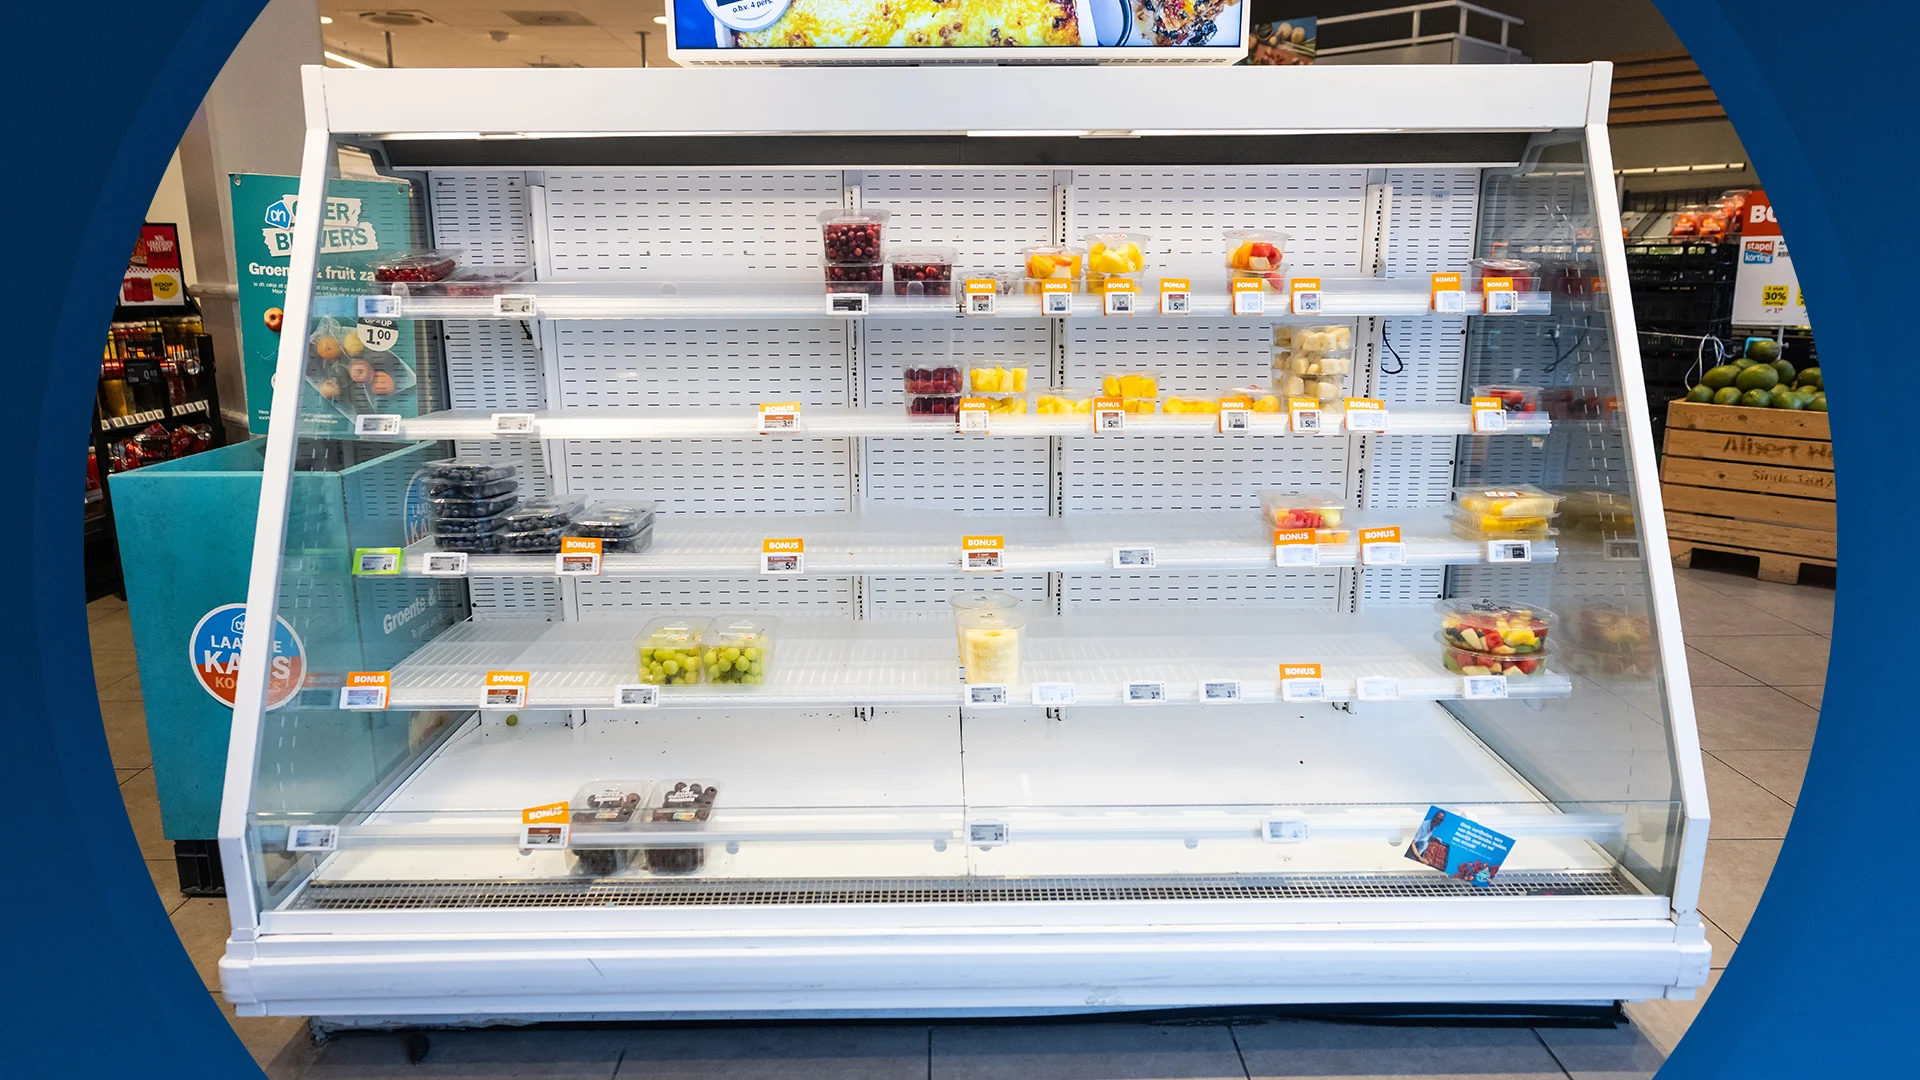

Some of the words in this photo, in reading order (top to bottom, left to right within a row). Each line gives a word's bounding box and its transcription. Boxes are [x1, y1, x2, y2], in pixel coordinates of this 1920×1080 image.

[732, 5, 749, 13] o.b.v.
[1746, 241, 1773, 251] stapel
[1745, 252, 1772, 264] korting
[325, 265, 356, 281] fruit
[1764, 292, 1786, 300] 30%
[366, 329, 391, 345] 1.00
[764, 405, 795, 413] BONUS
[1349, 401, 1379, 409] BONUS
[1723, 437, 1798, 458] Albert
[1279, 532, 1309, 541] BONUS
[1364, 530, 1395, 539] BONUS
[566, 541, 596, 549] BONUS
[383, 597, 426, 634] Groente
[428, 588, 436, 606] &
[204, 650, 291, 679] KAS
[1284, 667, 1315, 675] BONUS
[354, 675, 385, 683] BONUS
[529, 806, 563, 820] BONUS
